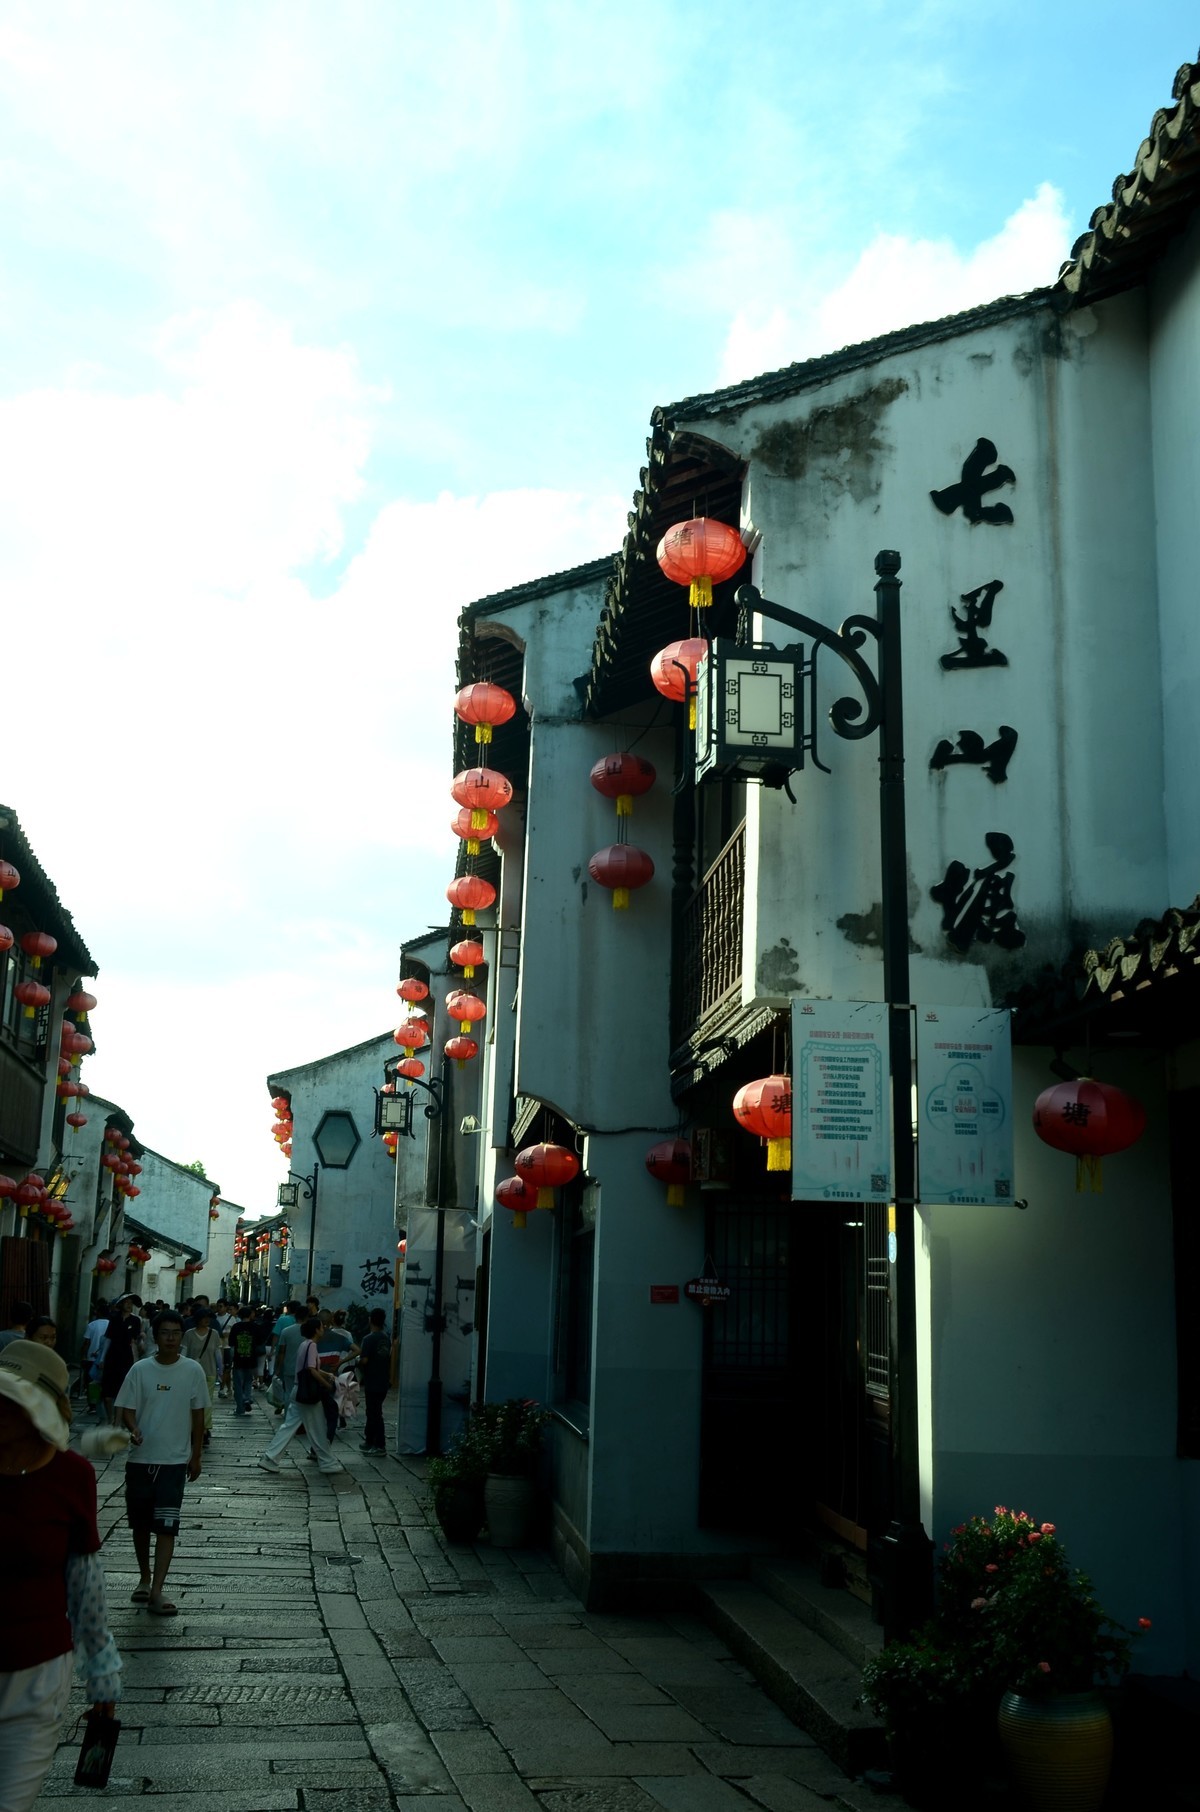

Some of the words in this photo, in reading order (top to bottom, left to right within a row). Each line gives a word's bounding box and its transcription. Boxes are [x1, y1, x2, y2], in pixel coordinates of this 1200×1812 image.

[673, 527, 694, 547] 塘
[929, 436, 1027, 953] 七里山塘
[607, 761, 622, 776] 山
[475, 775, 490, 788] 山
[771, 1093, 792, 1114] 塘
[1062, 1102, 1091, 1127] 塘
[359, 1256, 395, 1299] 蘇
